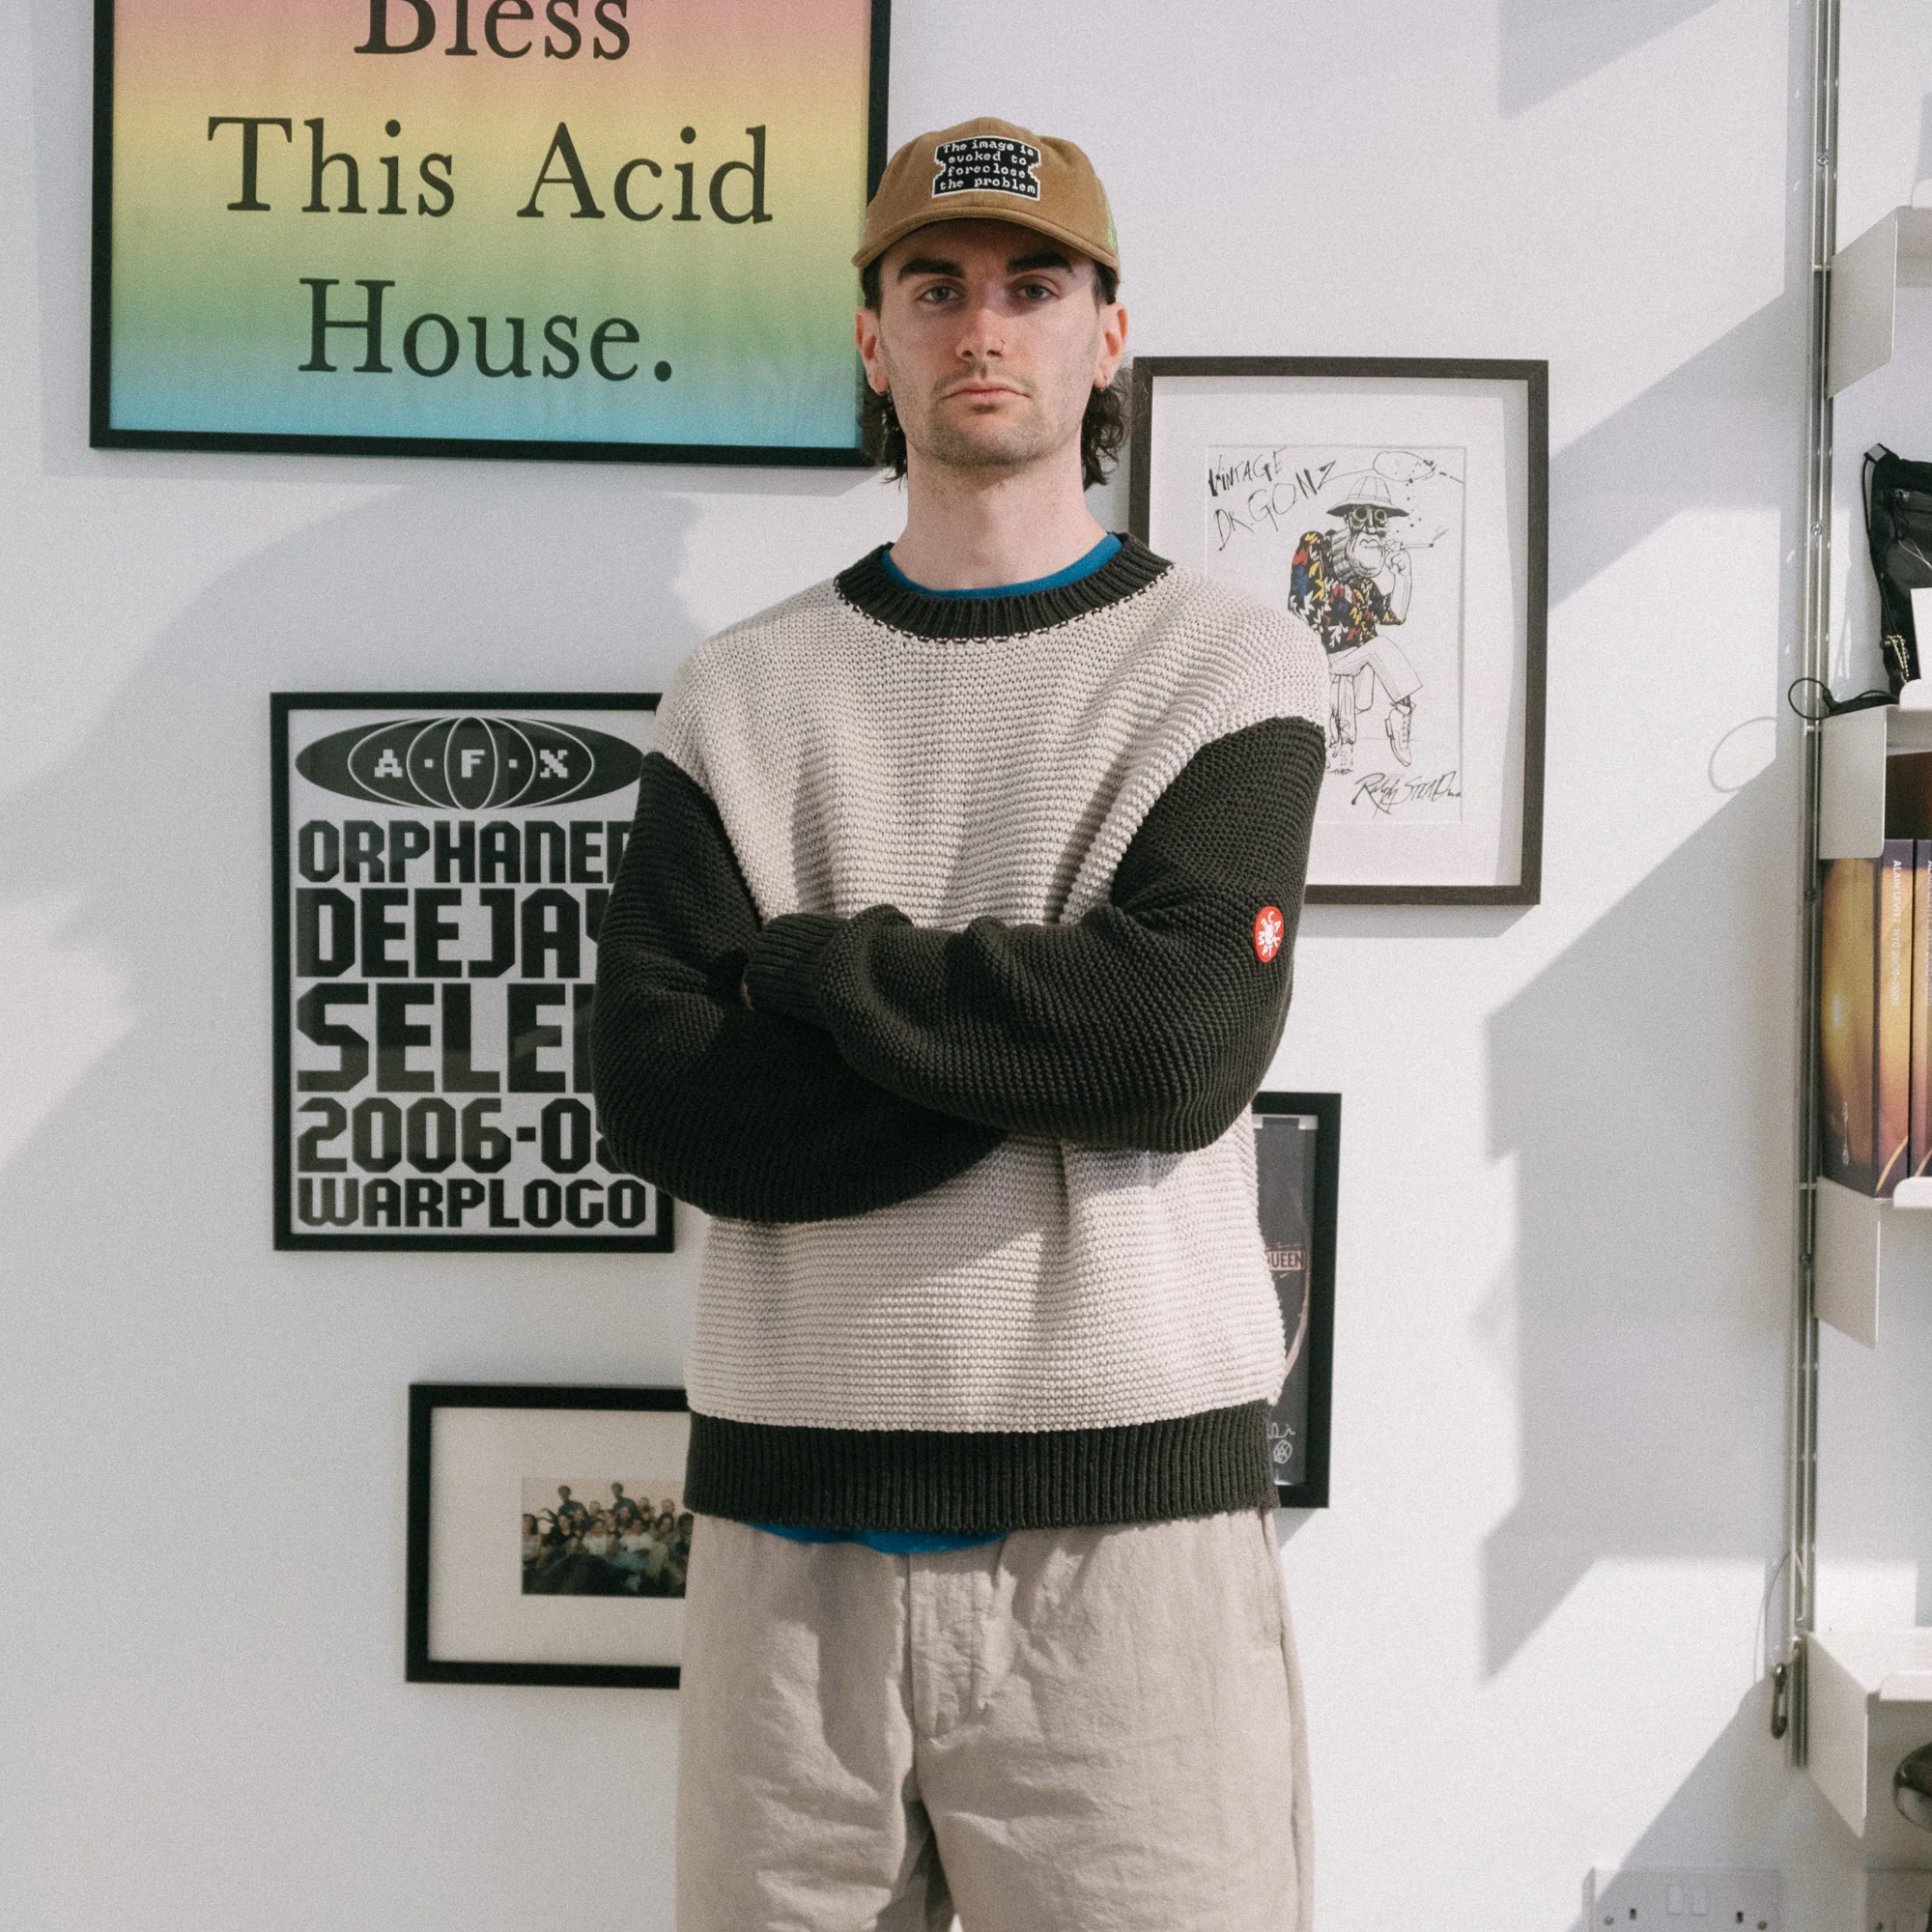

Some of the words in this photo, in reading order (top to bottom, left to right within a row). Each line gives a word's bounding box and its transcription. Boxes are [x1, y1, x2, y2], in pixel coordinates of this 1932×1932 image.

[354, 0, 630, 60] Bless
[943, 143, 967, 154] The
[972, 140, 1014, 152] image
[1020, 145, 1034, 156] is
[949, 152, 1001, 163] evoked
[1010, 155, 1027, 165] to
[208, 115, 455, 218] This
[517, 122, 773, 224] Acid
[948, 163, 1025, 178] foreclose
[940, 180, 964, 190] the
[974, 177, 1036, 194] problem
[298, 276, 673, 383] House.
[1893, 860, 1902, 890] ALAIN
[298, 1178, 646, 1229] WARPLOGO
[1267, 1251, 1305, 1268] UEEN
